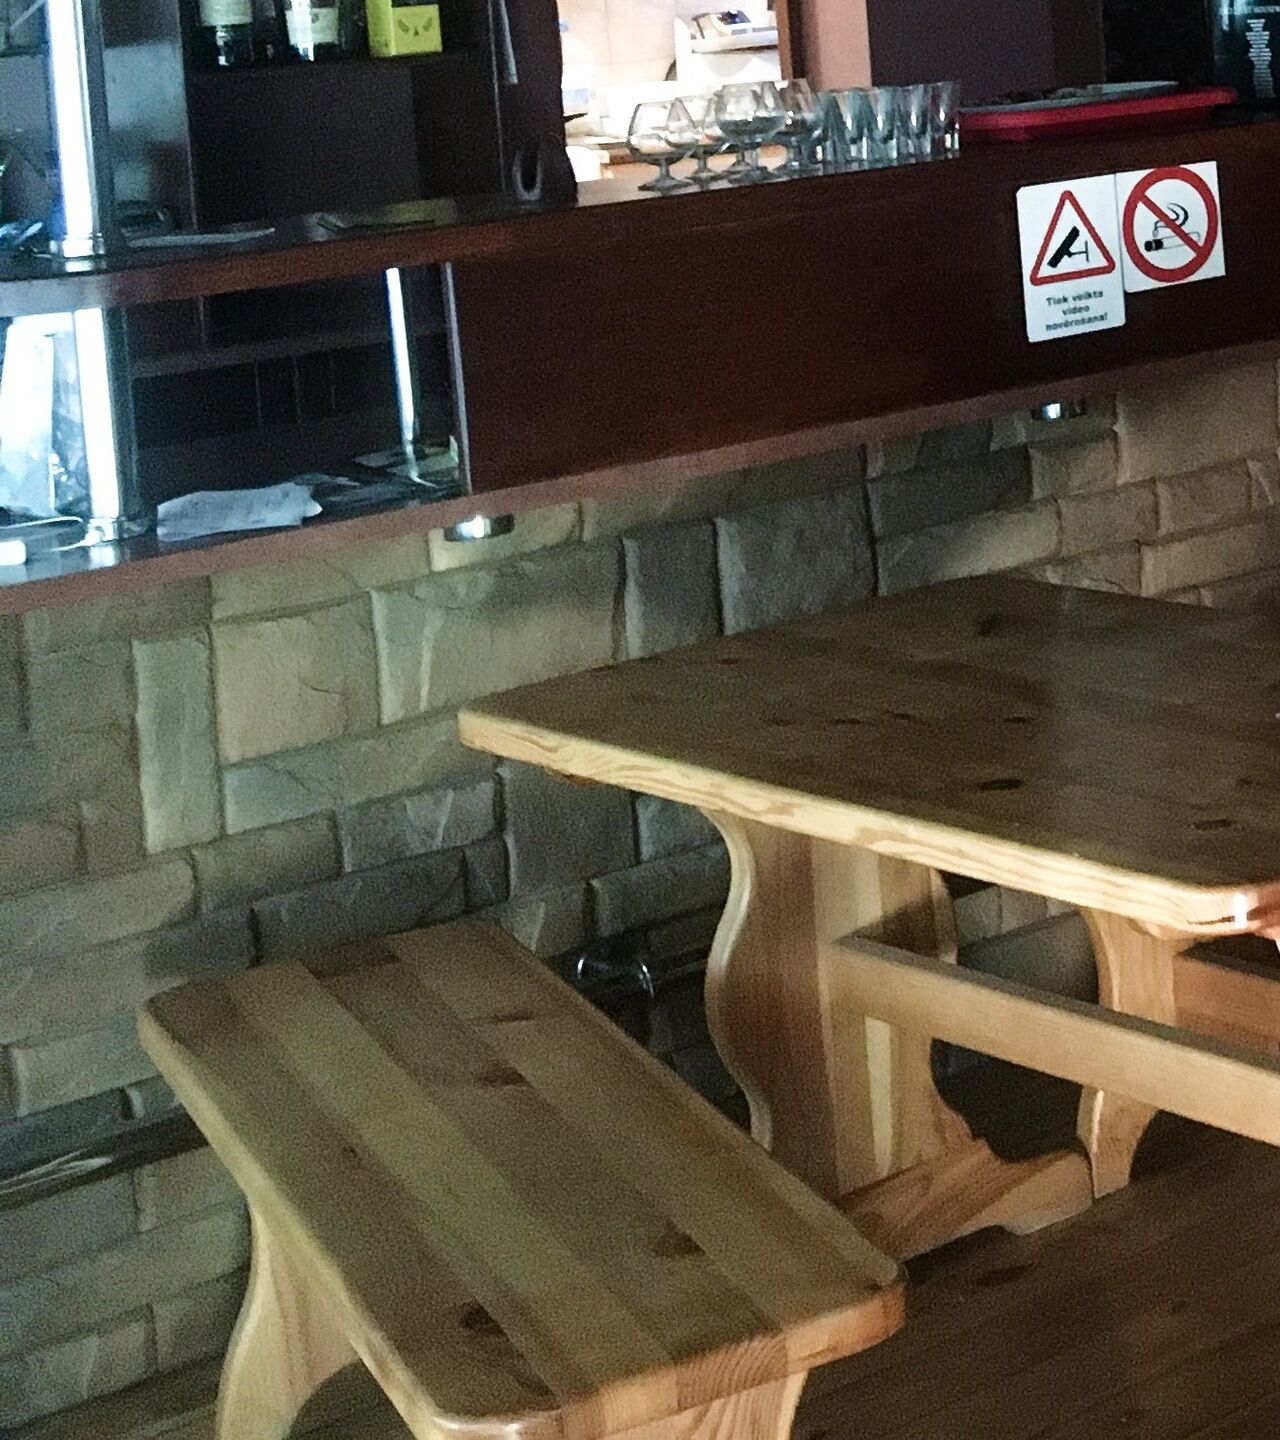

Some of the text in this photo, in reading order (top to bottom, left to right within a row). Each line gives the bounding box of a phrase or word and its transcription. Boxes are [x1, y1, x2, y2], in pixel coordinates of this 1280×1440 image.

[1046, 291, 1103, 306] Tiek veikta
[1062, 305, 1090, 315] video
